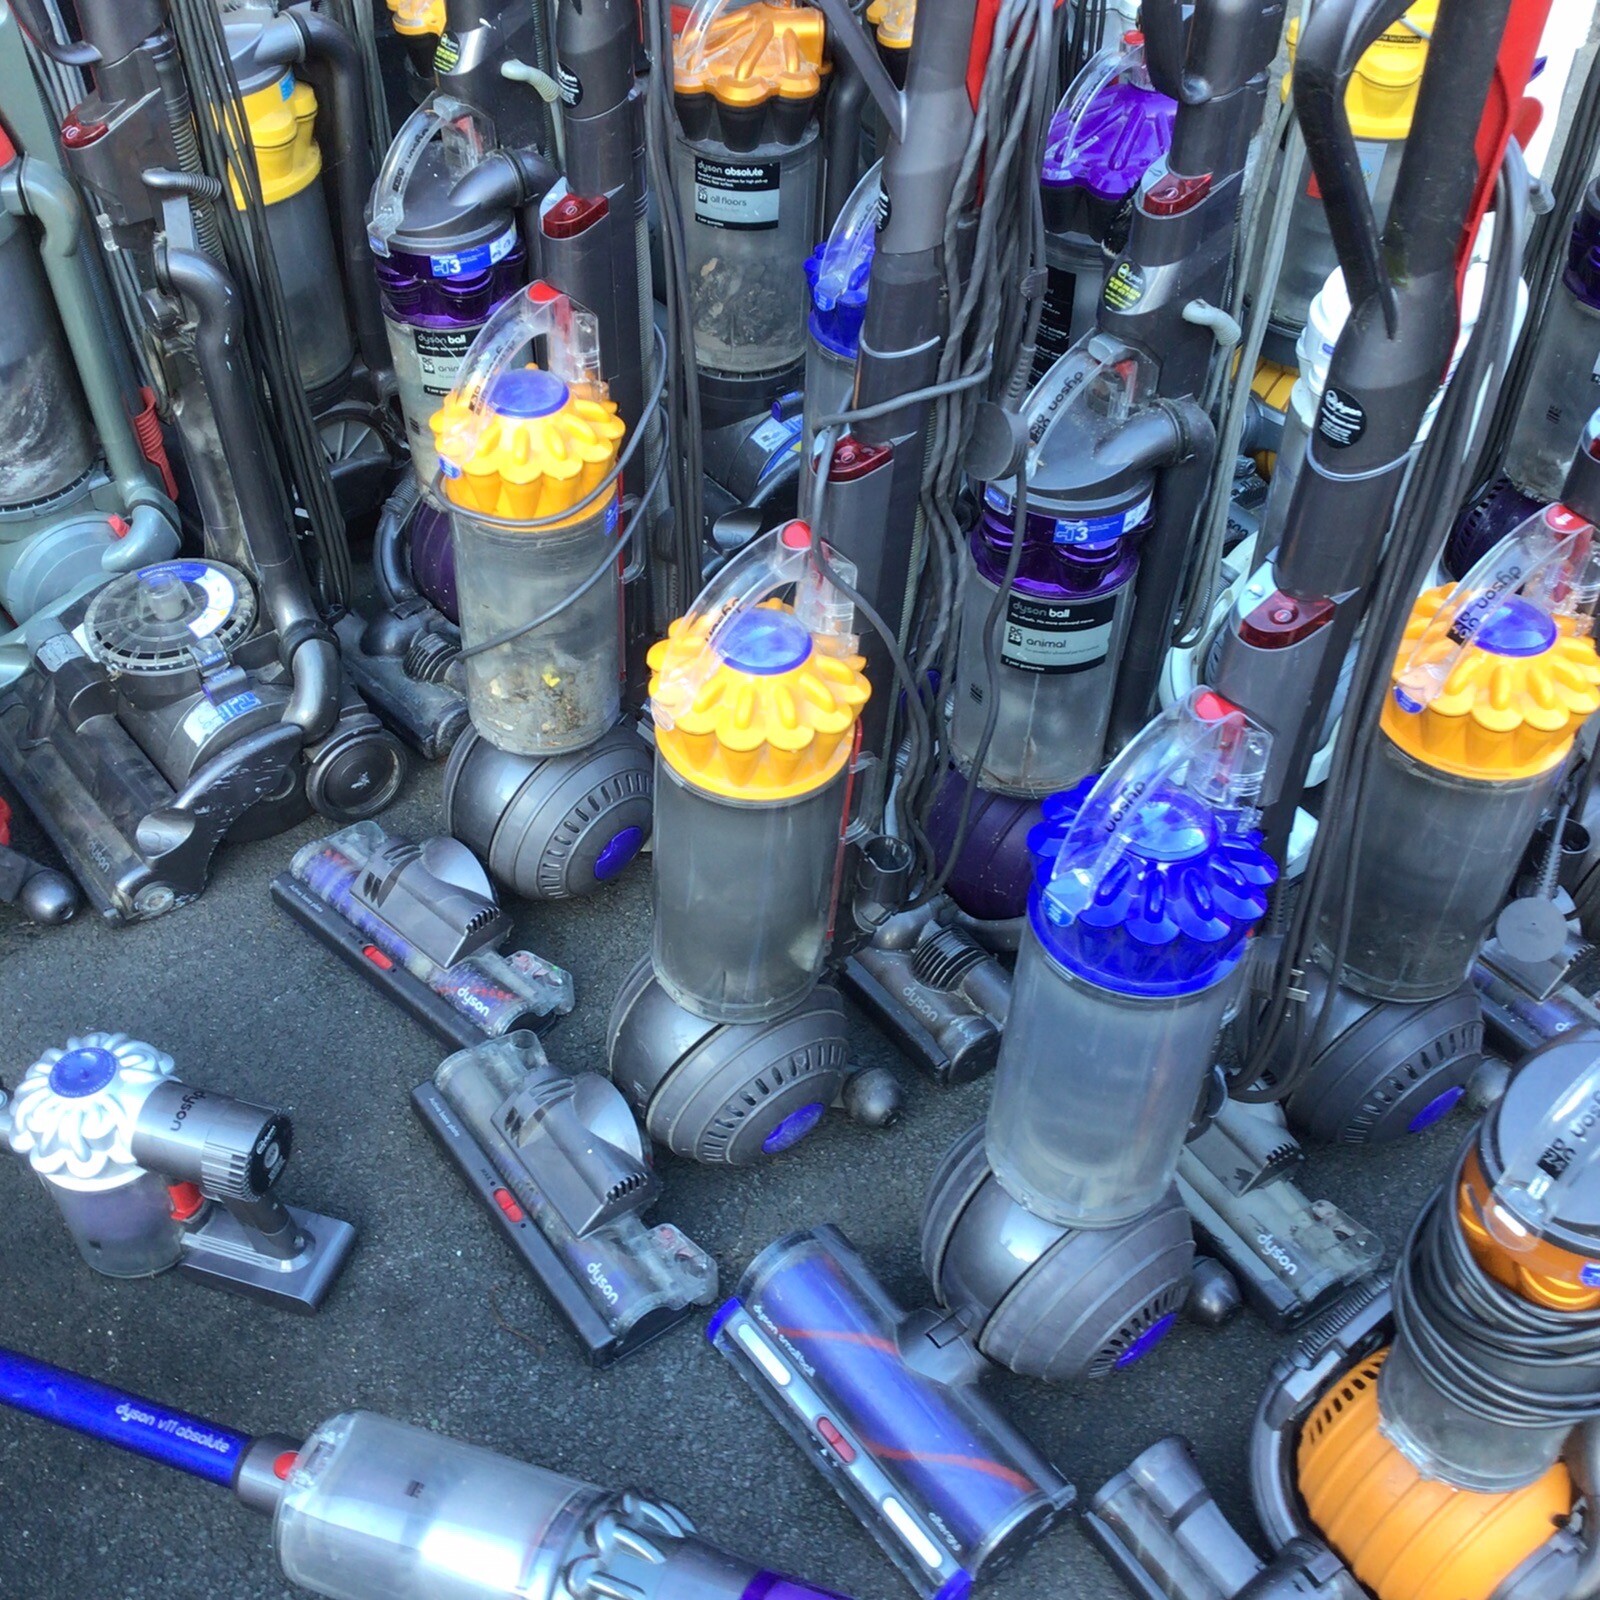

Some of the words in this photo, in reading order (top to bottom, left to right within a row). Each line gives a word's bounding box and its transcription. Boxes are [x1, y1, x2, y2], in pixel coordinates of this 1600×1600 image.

[697, 160, 723, 174] dyson
[724, 167, 764, 177] absolute
[710, 195, 720, 203] all
[721, 196, 747, 207] floors
[450, 258, 461, 273] 3
[417, 333, 447, 345] dyson
[447, 334, 467, 344] ball
[1048, 371, 1083, 411] dyson
[1036, 414, 1051, 428] DC
[1075, 527, 1089, 542] 3
[1476, 566, 1521, 609] dyson
[1012, 602, 1047, 616] dyson
[1048, 608, 1070, 618] ball
[1460, 611, 1480, 628] DC
[1010, 626, 1022, 634] DC
[1026, 638, 1066, 649] animal
[1105, 781, 1146, 833] dyson
[90, 840, 110, 873] dyson
[457, 986, 490, 1017] dyson
[903, 986, 938, 1022] dyson
[170, 1090, 206, 1132] dyson
[1257, 1234, 1297, 1276] dyson
[587, 1262, 619, 1305] dyson
[115, 1402, 155, 1426] dyson
[175, 1426, 230, 1453] absolute
